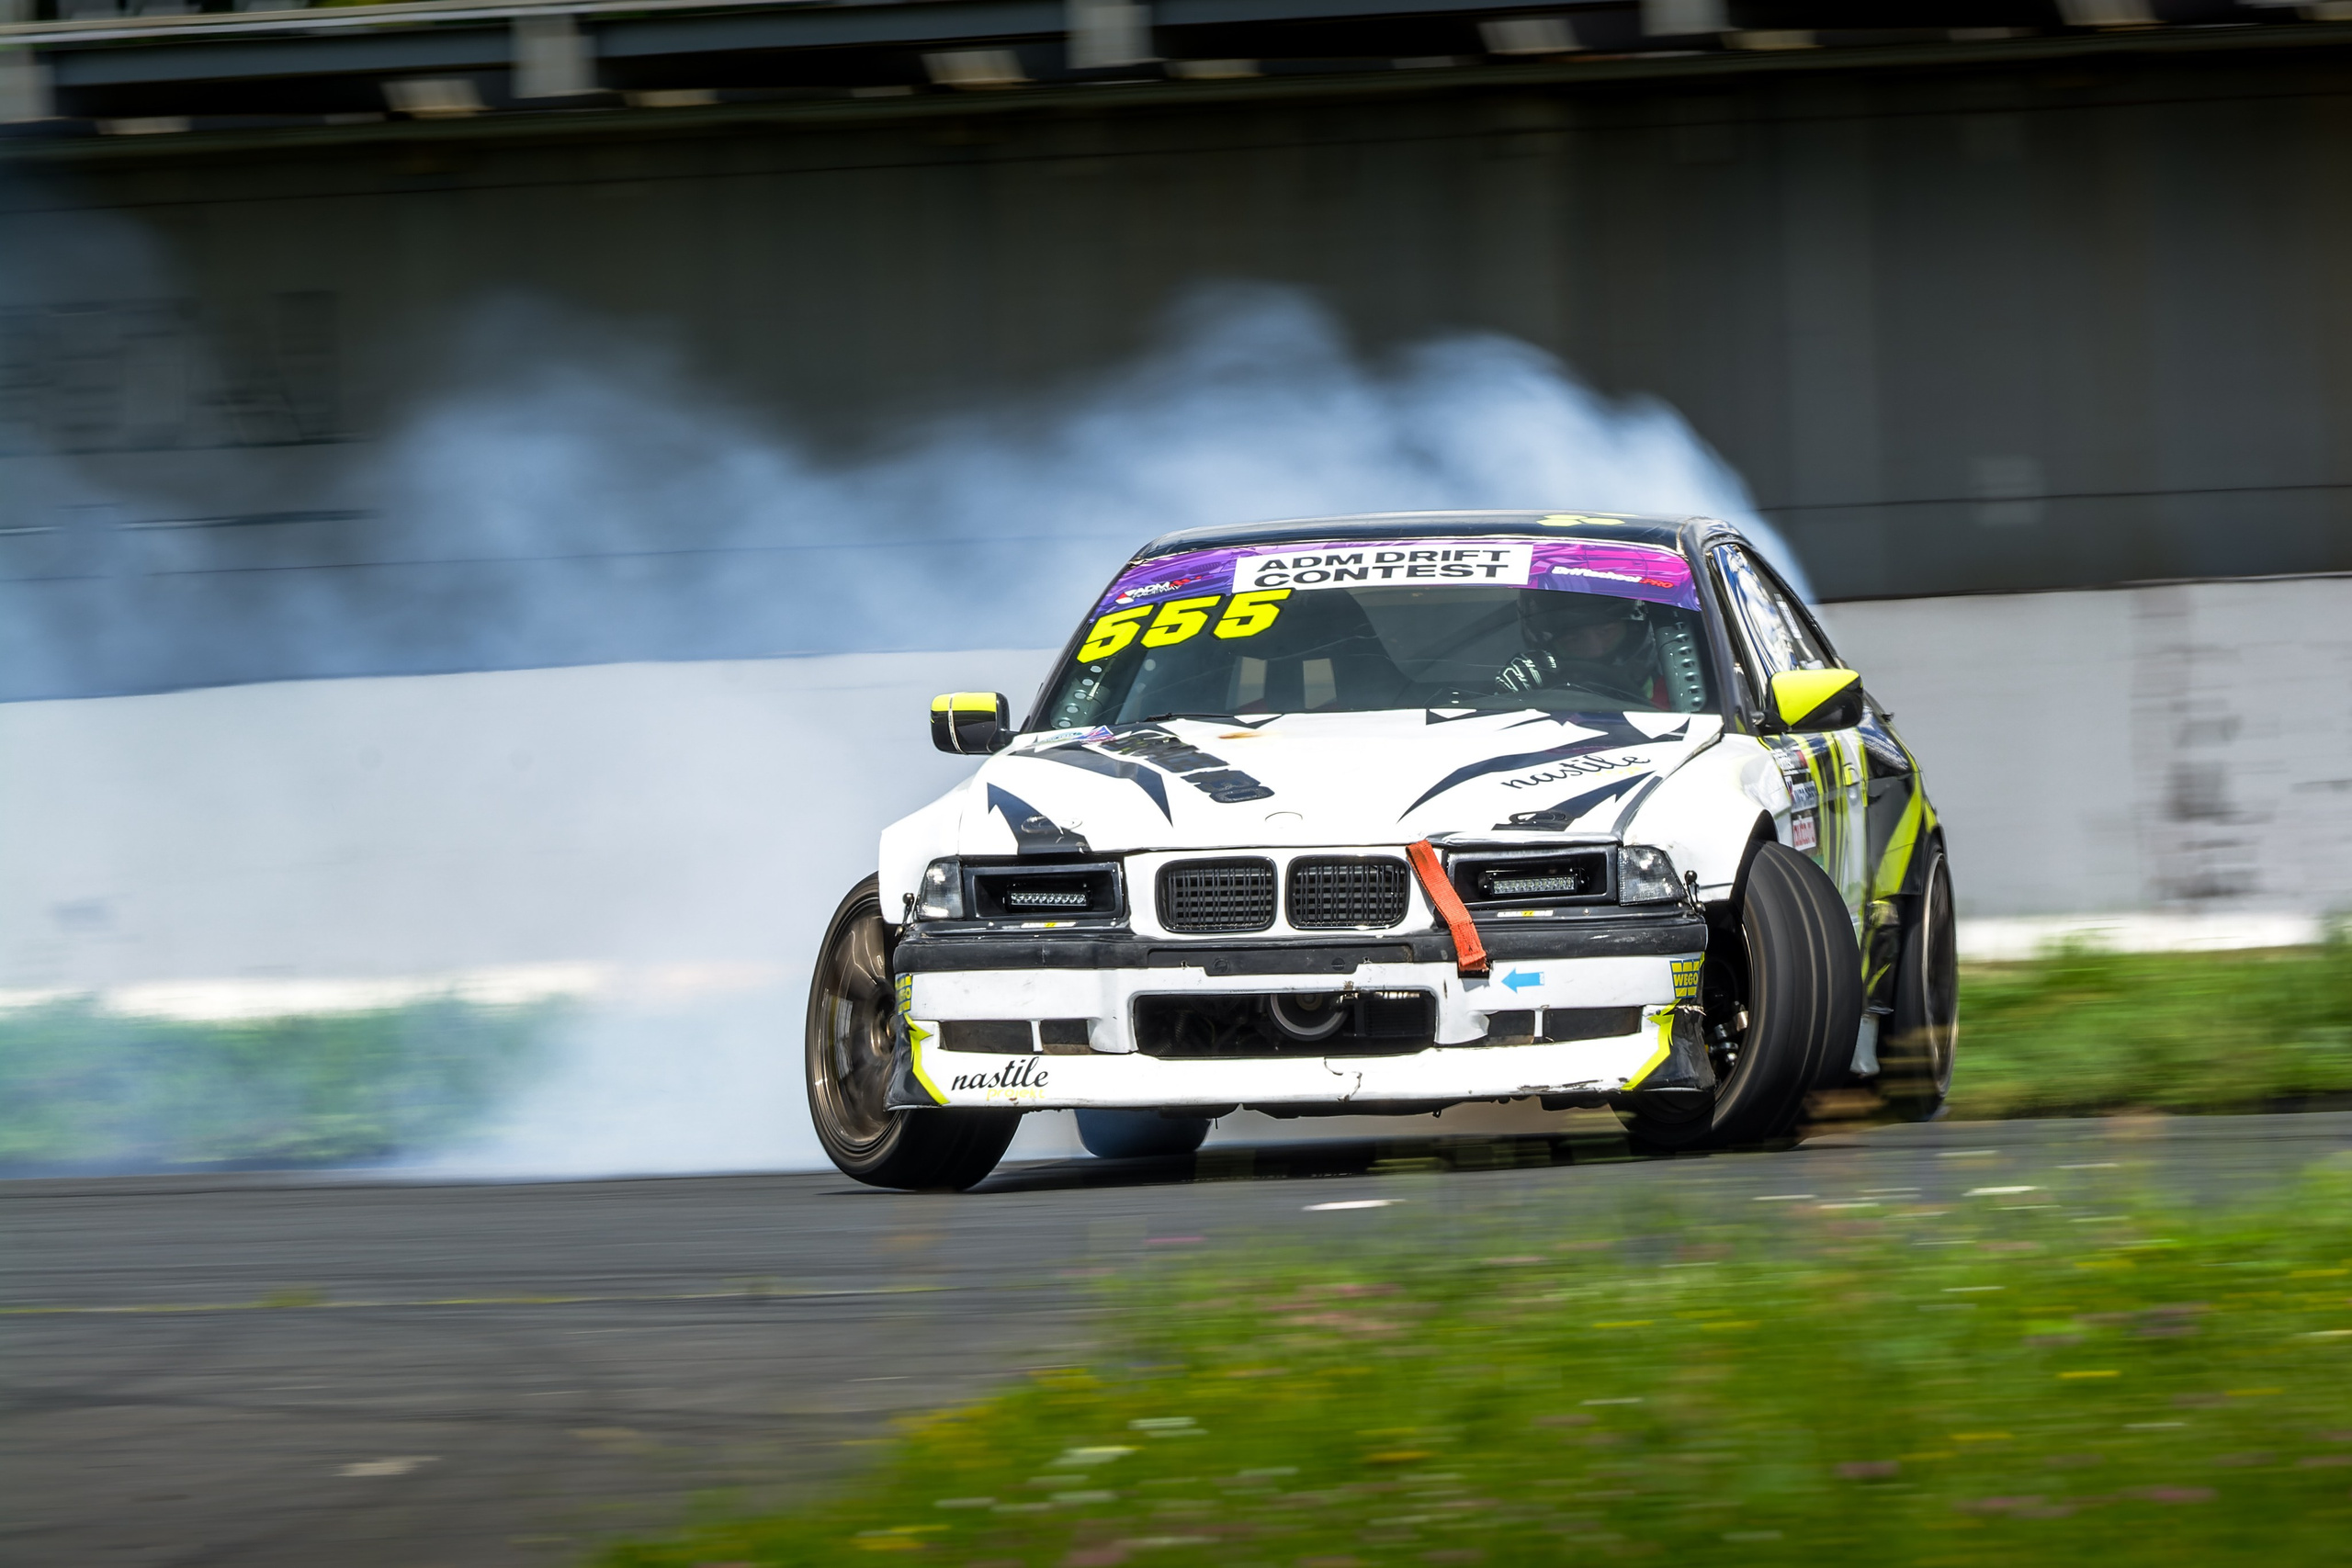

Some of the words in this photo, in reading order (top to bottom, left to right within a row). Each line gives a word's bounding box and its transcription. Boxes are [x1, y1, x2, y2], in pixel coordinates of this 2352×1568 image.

[1257, 553, 1363, 572] ADM
[1374, 549, 1511, 563] DRIFT
[1253, 564, 1510, 588] CONTEST
[1076, 588, 1292, 663] 555
[1500, 754, 1651, 789] nastile
[1673, 973, 1699, 987] WEGO
[951, 1055, 1049, 1091] nastile
[986, 1088, 1046, 1101] projekt
